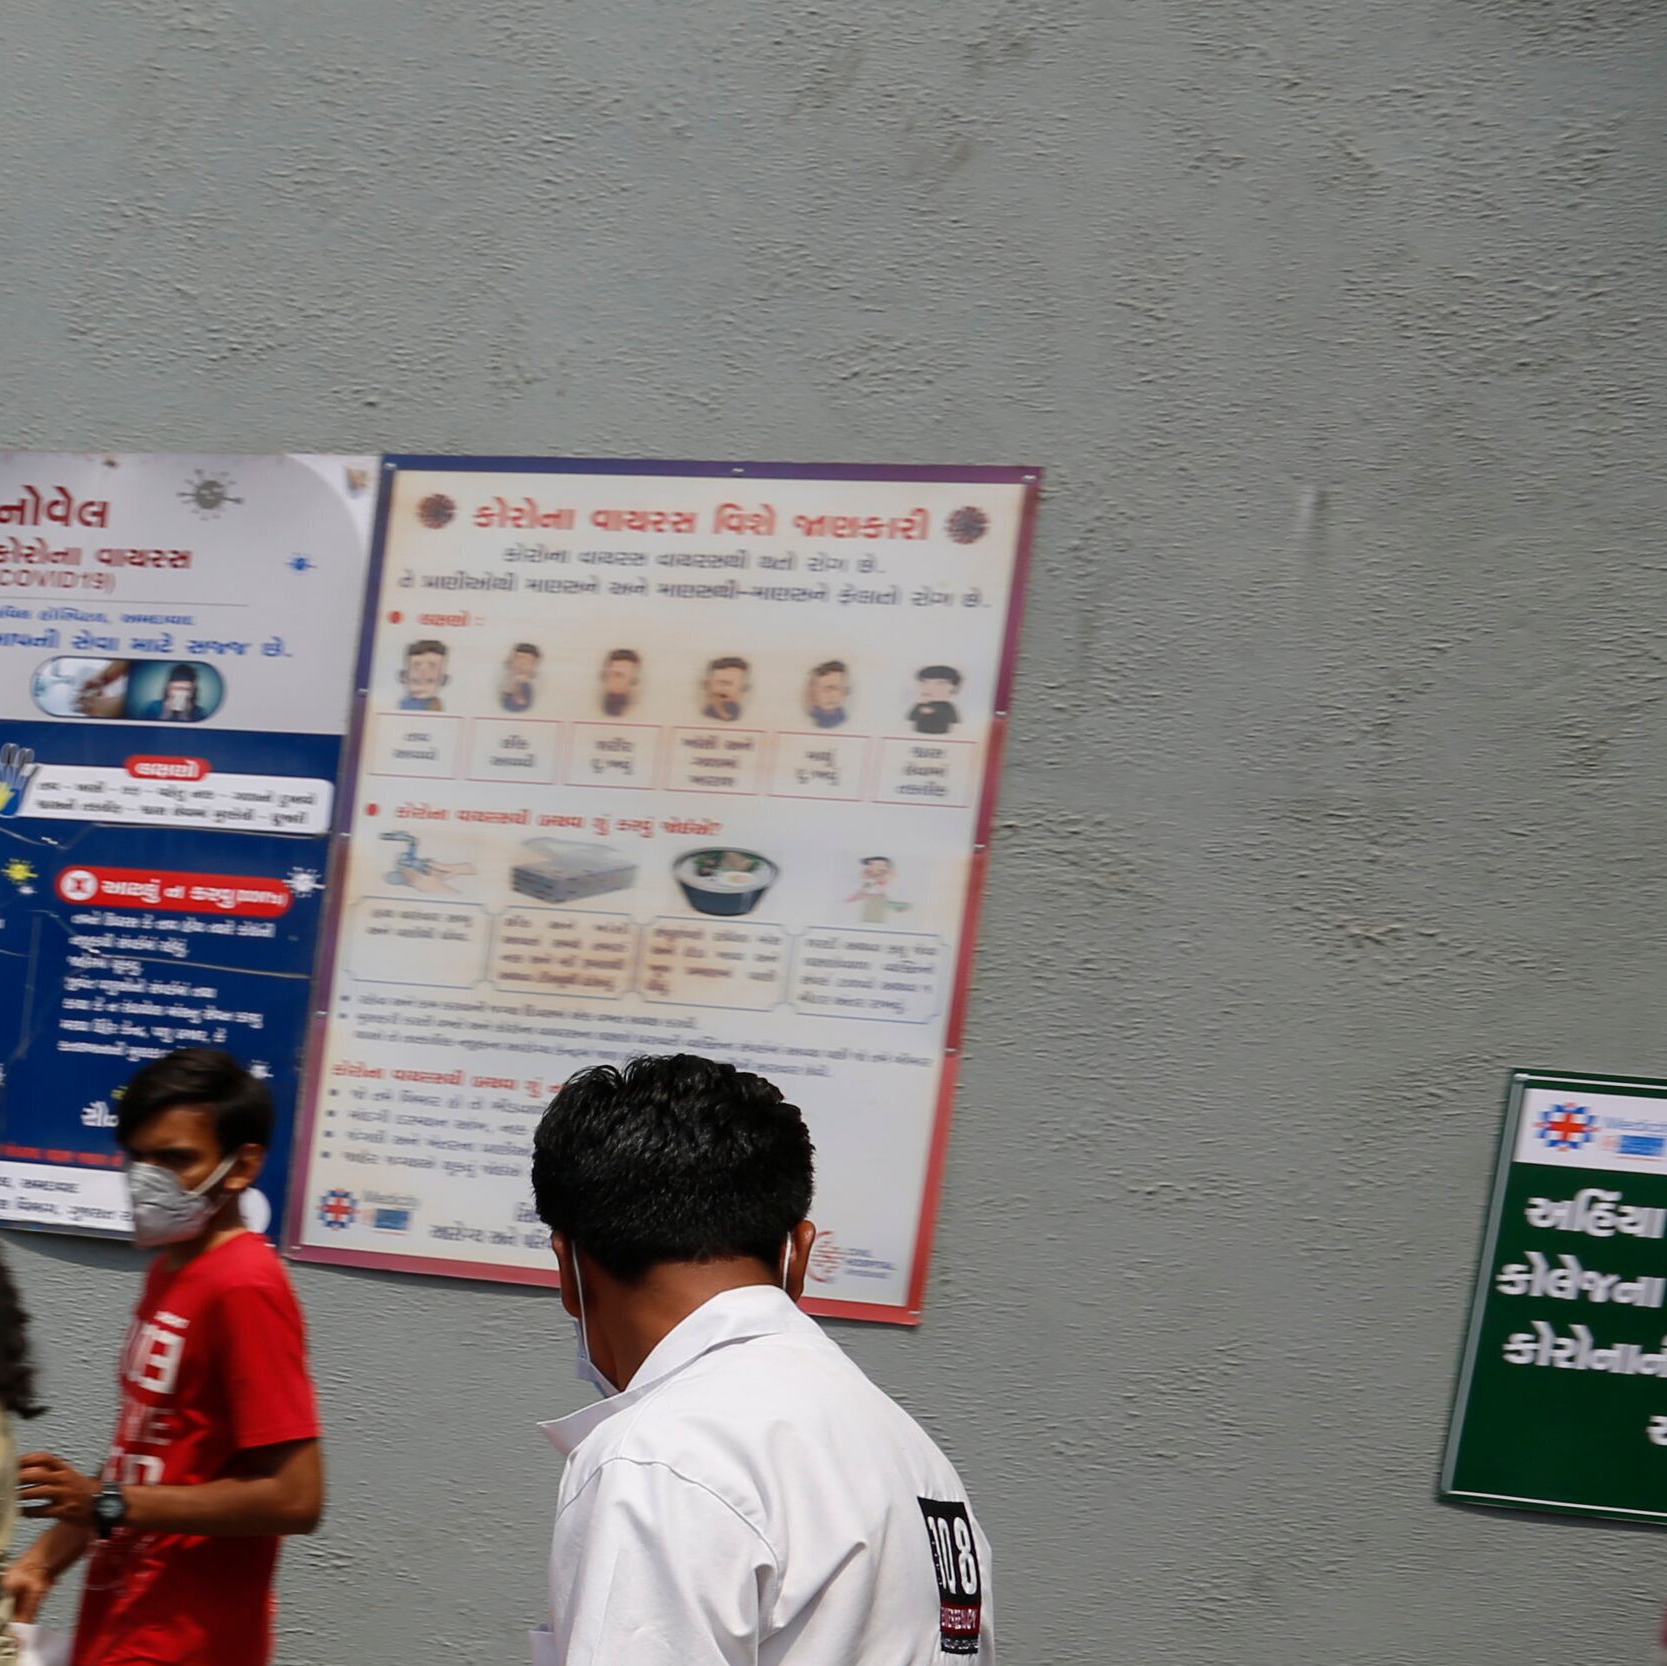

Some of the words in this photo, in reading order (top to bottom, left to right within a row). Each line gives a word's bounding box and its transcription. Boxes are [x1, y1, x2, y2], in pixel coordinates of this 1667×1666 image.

[473, 495, 575, 531] કોરોના
[589, 507, 697, 534] વાયરસ
[711, 502, 777, 536] વિશે
[792, 505, 928, 541] જાણકારી
[95, 549, 193, 569] વાયરસ
[503, 543, 569, 566] કોરોના
[71, 631, 121, 651] સેવા
[131, 633, 175, 653] માટે
[927, 1516, 977, 1595] 108
